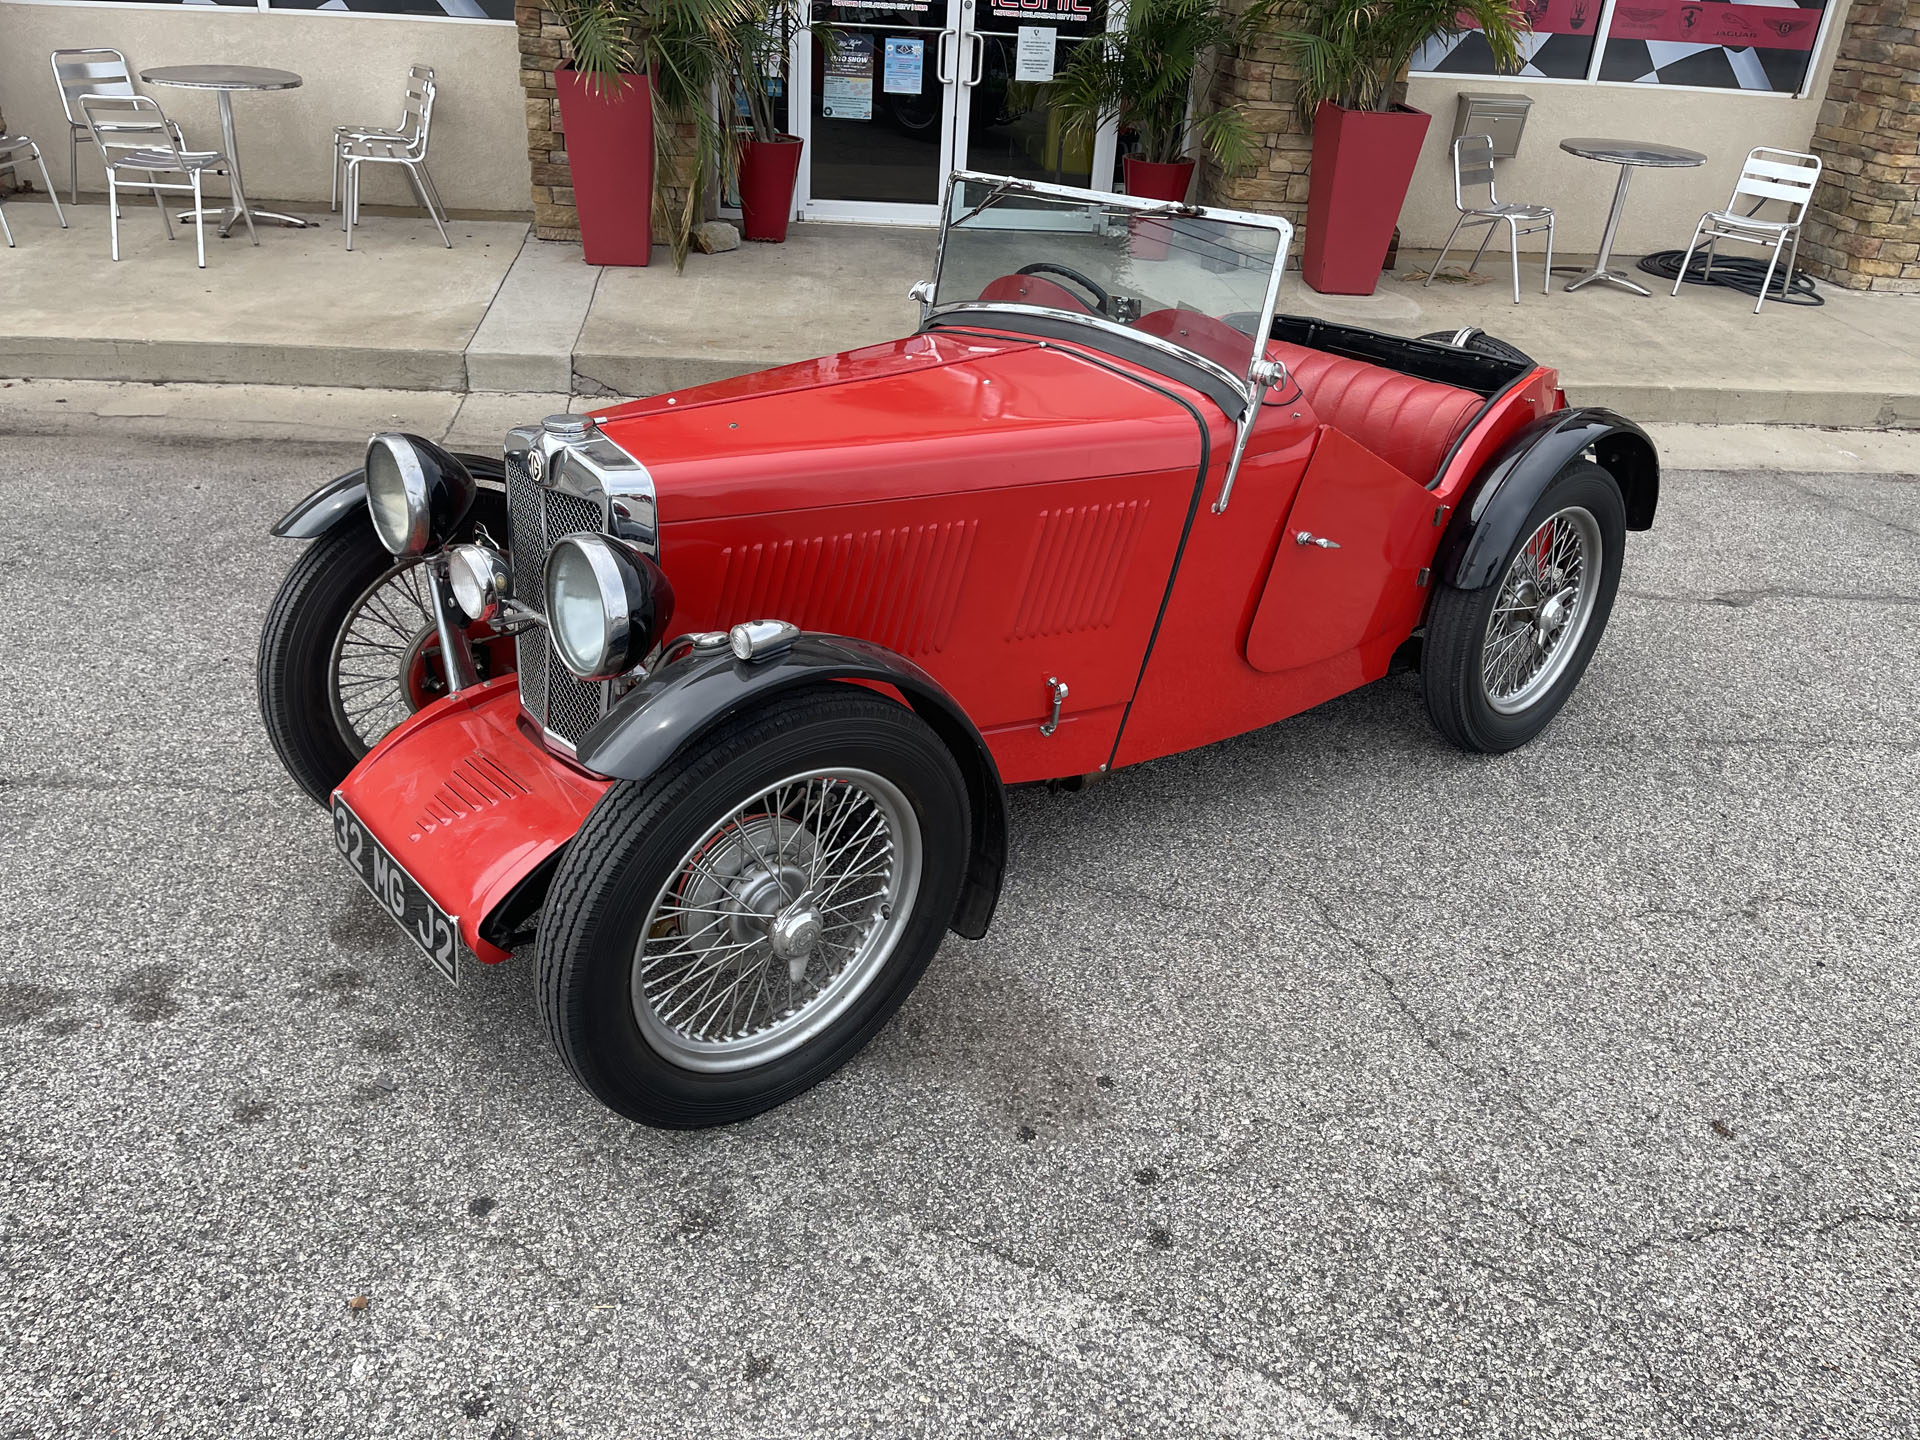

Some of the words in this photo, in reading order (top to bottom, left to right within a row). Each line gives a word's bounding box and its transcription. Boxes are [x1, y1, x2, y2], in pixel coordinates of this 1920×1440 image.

[862, 1, 896, 9] OKLAHOMA
[993, 9, 1019, 17] MOTORS
[1022, 11, 1056, 20] OKLAHOMA
[1057, 13, 1072, 21] CITY
[336, 806, 363, 873] 32
[373, 846, 405, 917] MG
[418, 905, 454, 975] J2
